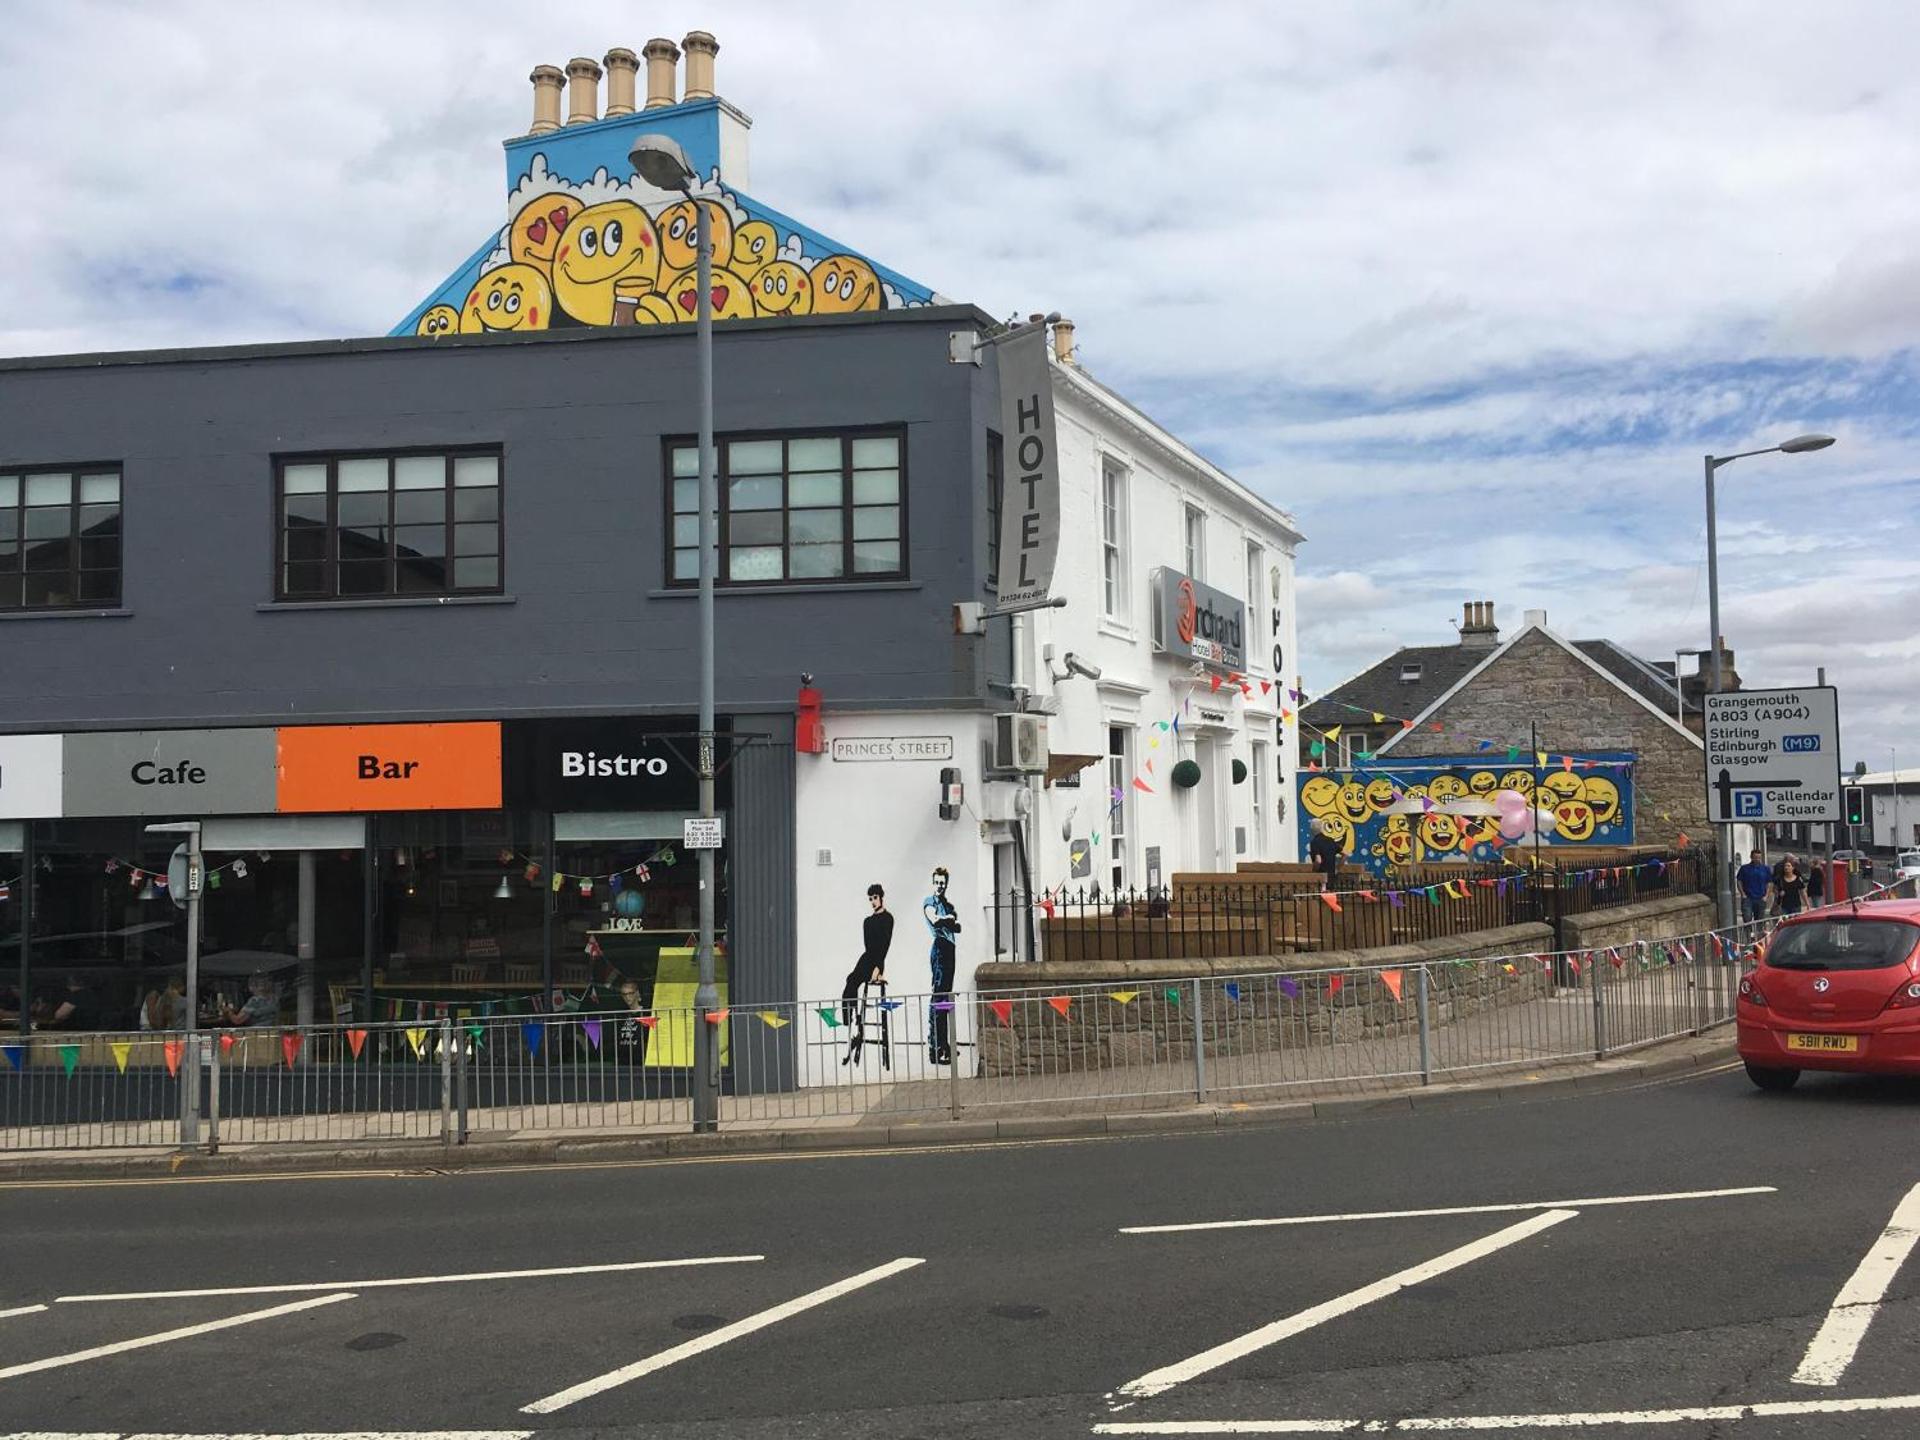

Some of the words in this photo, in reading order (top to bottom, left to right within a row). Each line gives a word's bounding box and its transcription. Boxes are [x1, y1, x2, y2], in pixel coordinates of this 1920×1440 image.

[1017, 394, 1043, 588] HOTEL
[1272, 607, 1284, 785] HOTEL
[1708, 694, 1800, 709] Grangemouth
[1709, 711, 1749, 722] A803
[1754, 706, 1810, 720] (A904)
[1710, 727, 1760, 739] Stirling
[838, 743, 893, 755] PRINCES
[900, 742, 948, 754] STREET
[1710, 740, 1777, 752] Edinburgh
[1784, 737, 1819, 750] (M9)
[358, 755, 419, 779] Bar
[562, 751, 668, 776] Bistro
[1711, 755, 1769, 766] Glasgow
[131, 760, 206, 785] Cafe
[1766, 790, 1835, 802] Callendar
[1740, 794, 1757, 815] P
[1777, 804, 1825, 816] Square
[609, 917, 643, 931] LOVE
[1798, 1035, 1820, 1049] SB11
[1824, 1036, 1847, 1049] RWU
